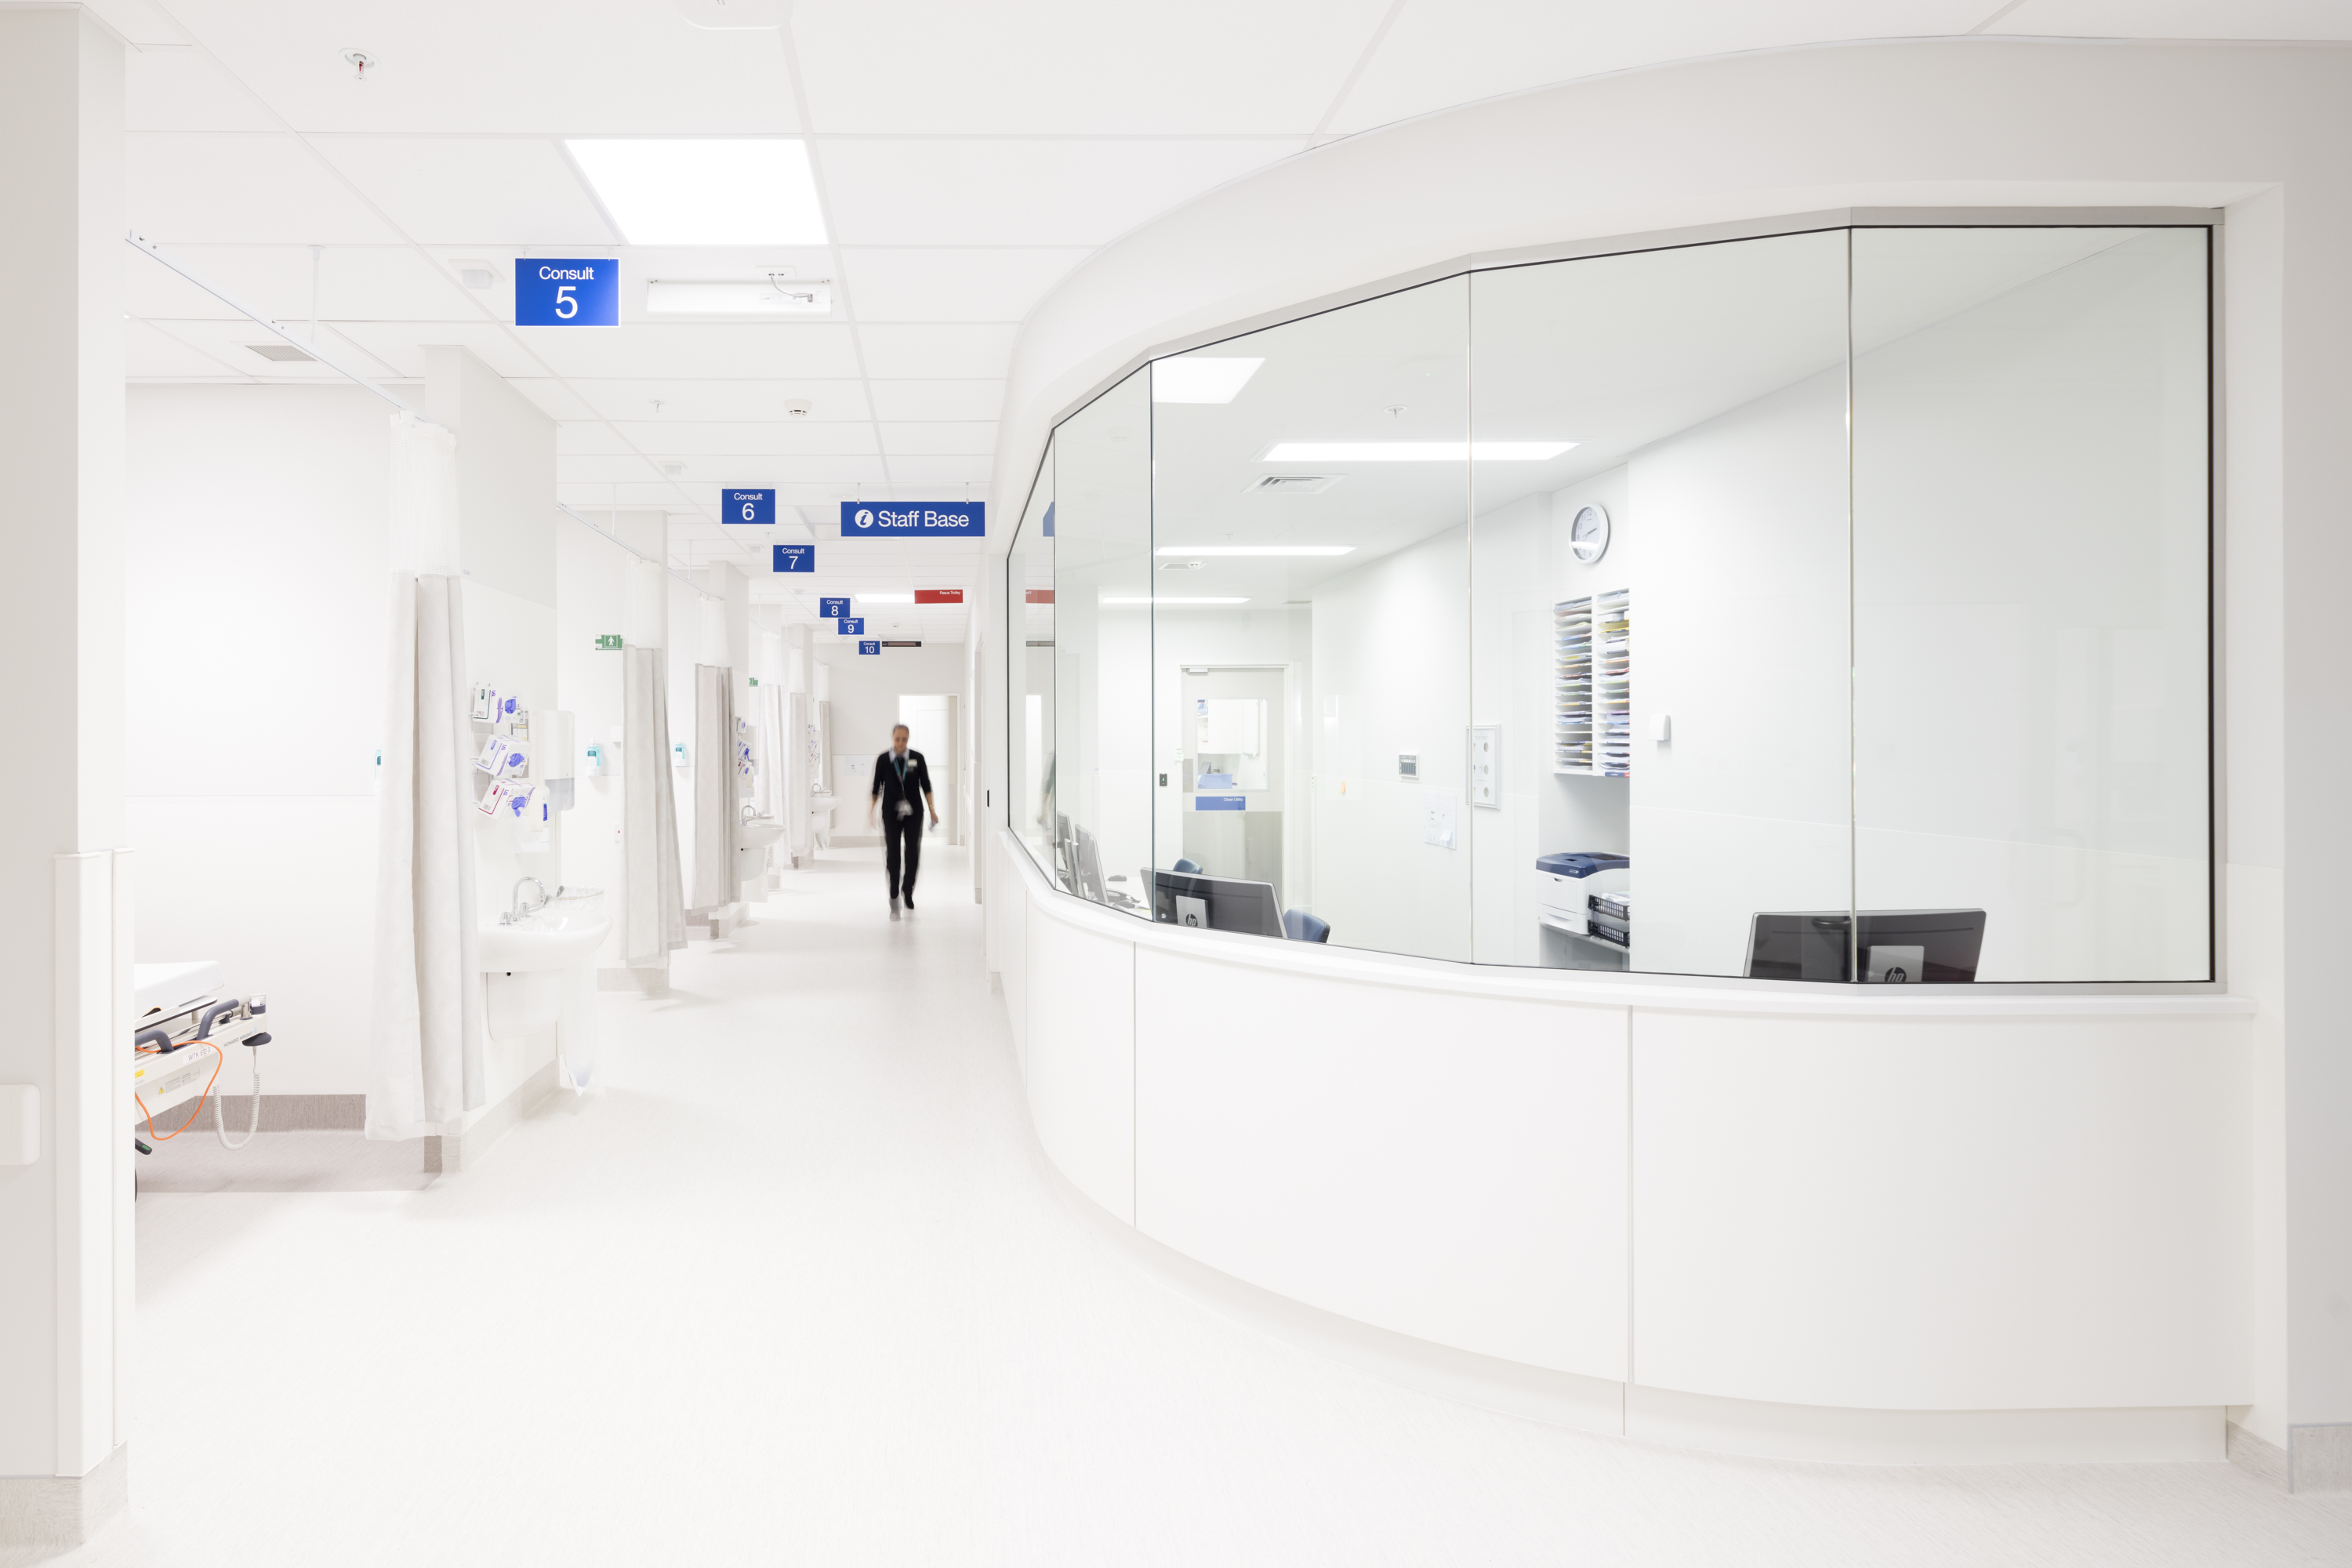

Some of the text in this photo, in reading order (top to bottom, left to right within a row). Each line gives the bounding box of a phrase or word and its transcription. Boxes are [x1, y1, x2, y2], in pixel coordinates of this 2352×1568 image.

[539, 266, 594, 280] Consult
[555, 286, 579, 319] 5
[734, 492, 763, 501] Consult
[742, 503, 755, 521] 6
[878, 510, 970, 528] Staff Base
[789, 555, 798, 570] 7
[831, 605, 839, 616] 8
[848, 624, 854, 633] 9
[1187, 913, 1197, 927] hp
[1887, 967, 1905, 982] hp
[223, 1031, 253, 1047] HOWARD WRIGHT
[188, 1051, 200, 1061] WTK
